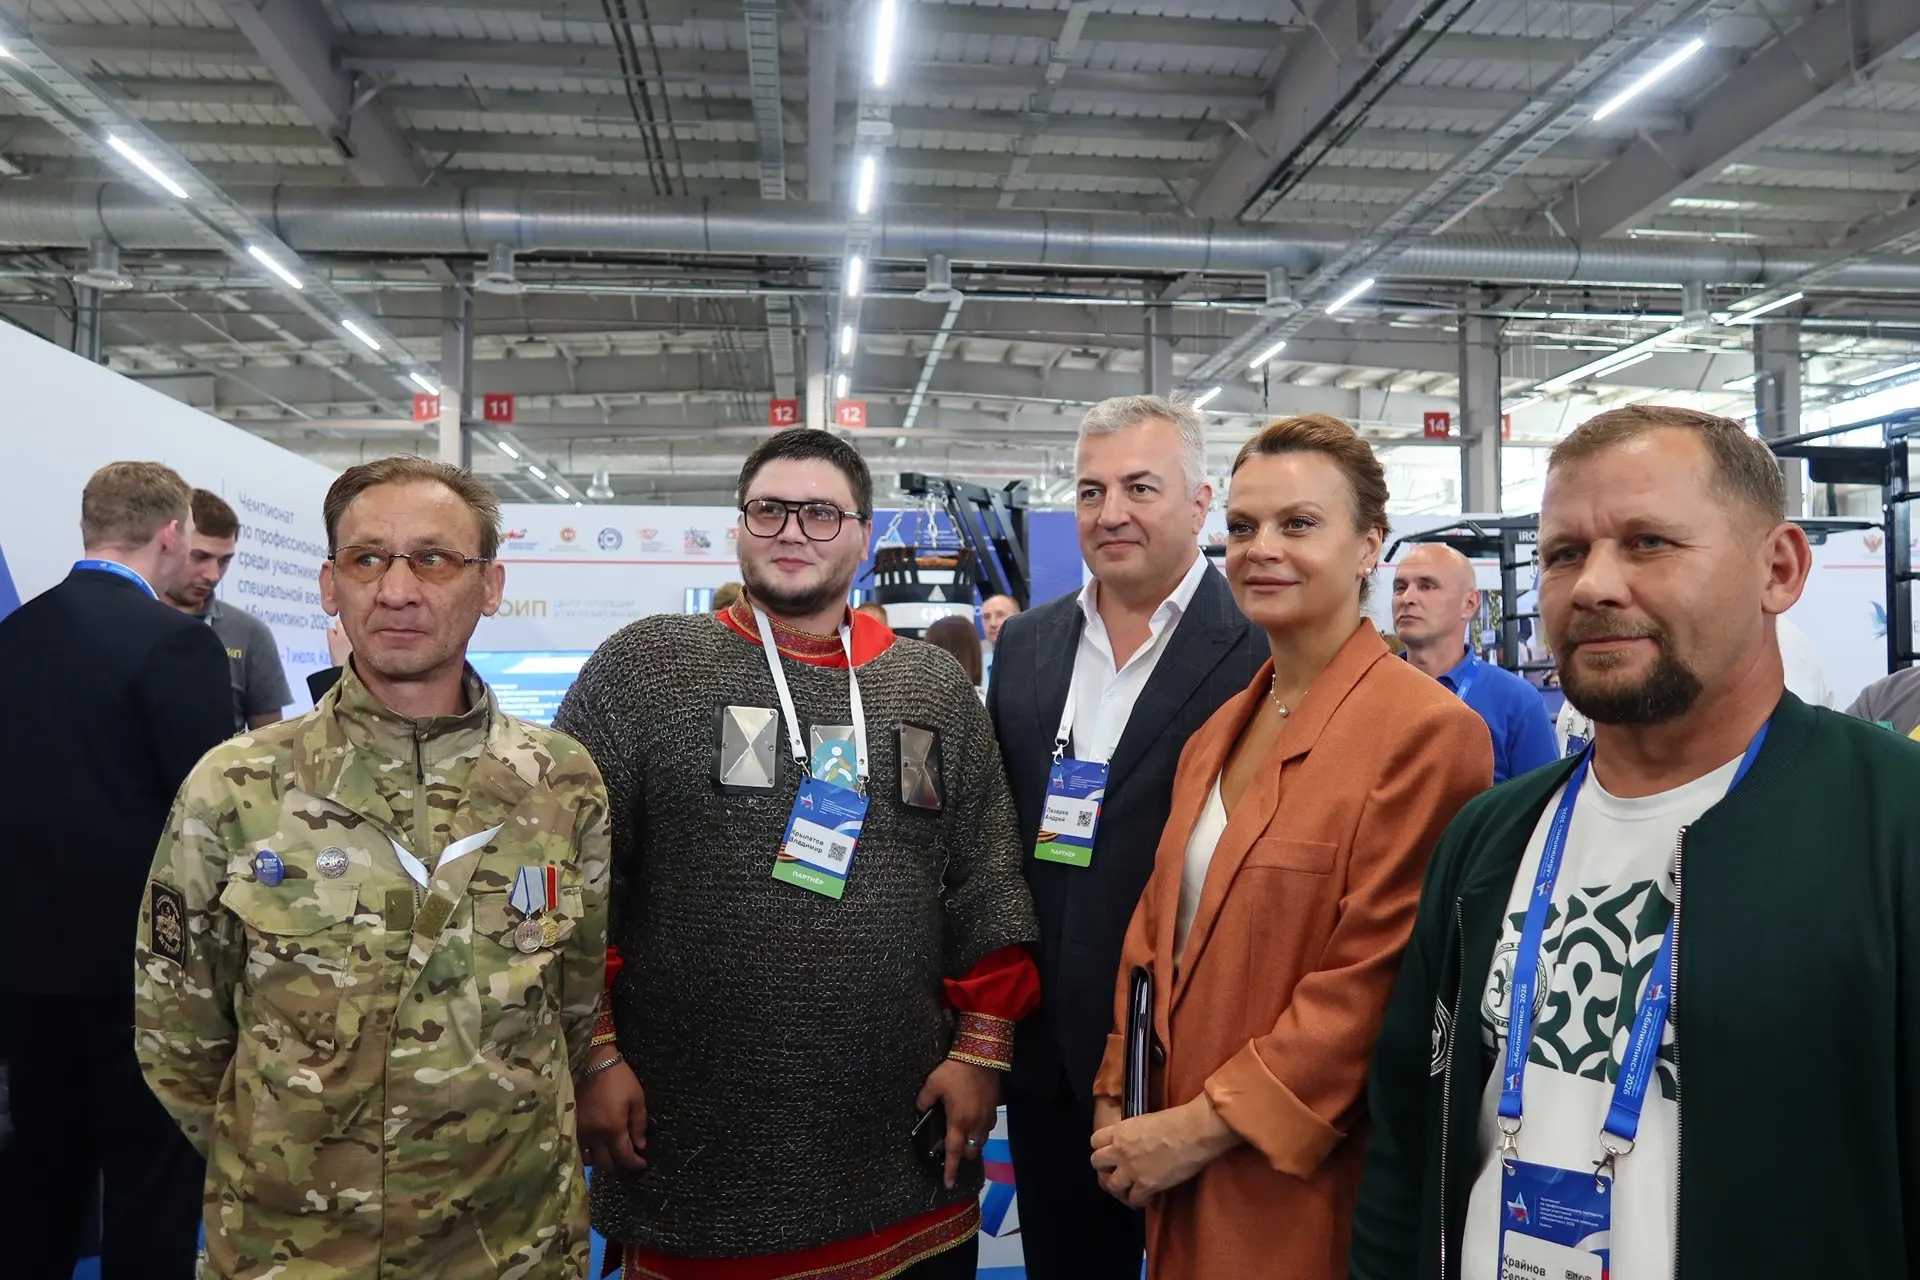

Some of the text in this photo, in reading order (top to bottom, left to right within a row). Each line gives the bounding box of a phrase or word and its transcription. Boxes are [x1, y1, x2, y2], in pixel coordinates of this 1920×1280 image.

[420, 400, 438, 417] 11
[490, 400, 508, 416] 11
[774, 406, 794, 421] 12
[841, 406, 861, 422] 12
[1428, 418, 1446, 432] 14
[239, 491, 294, 524] Чемпионат
[255, 527, 328, 559] профессиональ
[1518, 531, 1538, 541] IRO
[238, 551, 320, 582] среди участнико
[238, 579, 303, 604] специальной
[493, 599, 547, 620] ОИП
[1045, 815, 1065, 823] Андрей
[1050, 847, 1076, 858] ПАРТНЁР
[792, 870, 824, 885] ПАРТНЁР
[1519, 983, 1528, 1004] 2026
[1514, 1005, 1526, 1068] «Абилимпикс»
[1630, 1006, 1653, 1072] «Абилимпикс»
[1622, 1072, 1635, 1096] 2026
[1503, 1254, 1546, 1277] Крайнов
